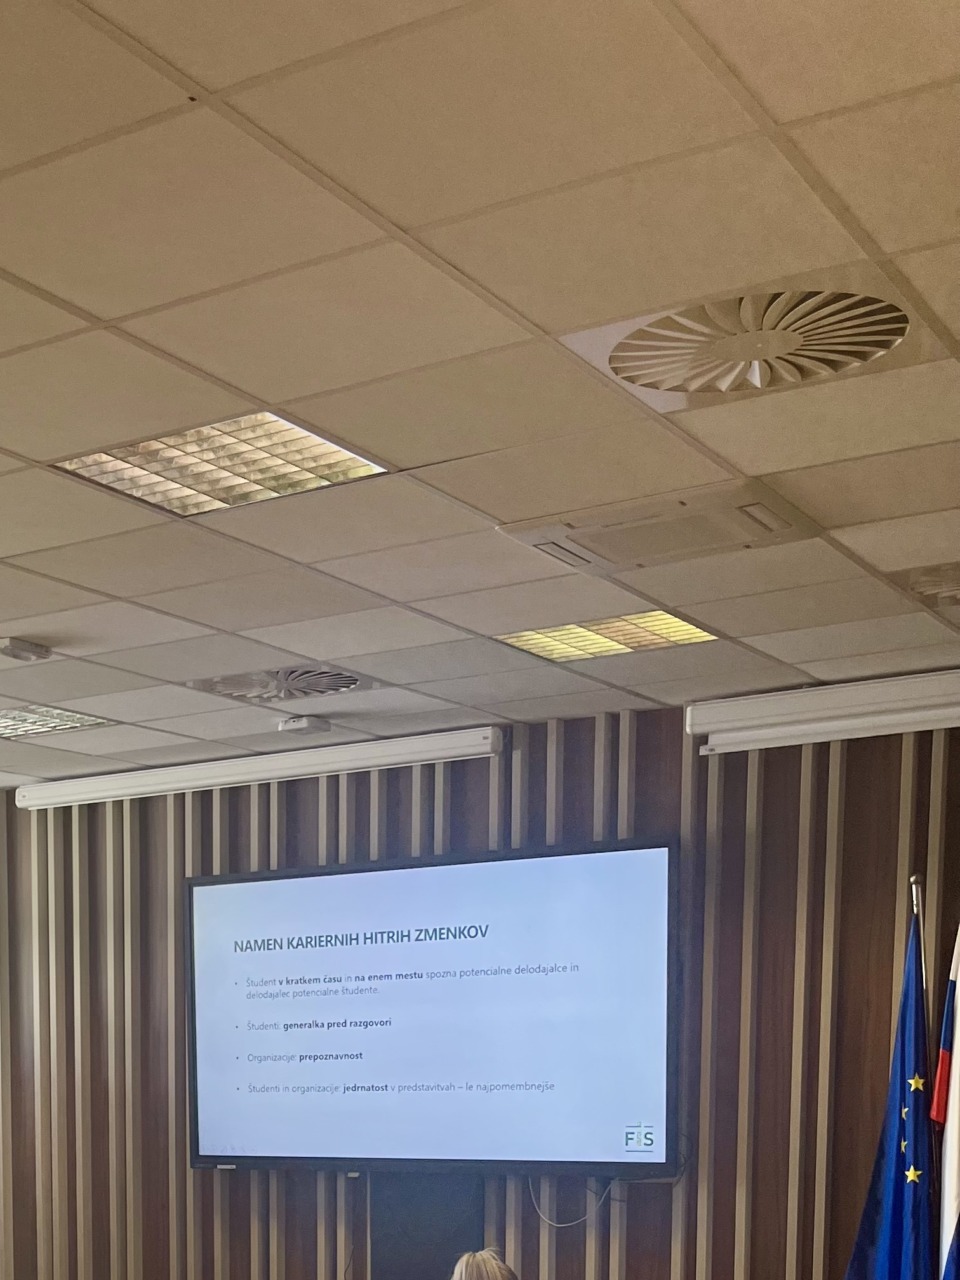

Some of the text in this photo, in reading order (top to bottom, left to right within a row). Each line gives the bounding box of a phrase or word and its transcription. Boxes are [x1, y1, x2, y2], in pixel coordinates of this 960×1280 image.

[234, 924, 489, 953] NAMEN KARIERNIH HITRIH ZMENKOV
[246, 962, 579, 988] Študent v kratkem času in na enem mestu spozna potencialne delodajalce in
[246, 989, 290, 1000] delodajalec
[292, 987, 339, 999] potencialne
[283, 1019, 325, 1032] generalka
[327, 1018, 347, 1031] pred
[349, 1016, 392, 1029] razgovori
[299, 1052, 363, 1063] prepoznavnost
[248, 1083, 280, 1093] Študenti
[282, 1083, 290, 1093] in
[342, 1083, 388, 1095] jedrnatost
[390, 1084, 396, 1092] v
[397, 1082, 455, 1094] predstavitvah
[465, 1081, 474, 1092] le
[476, 1080, 555, 1094] najpomembnejše
